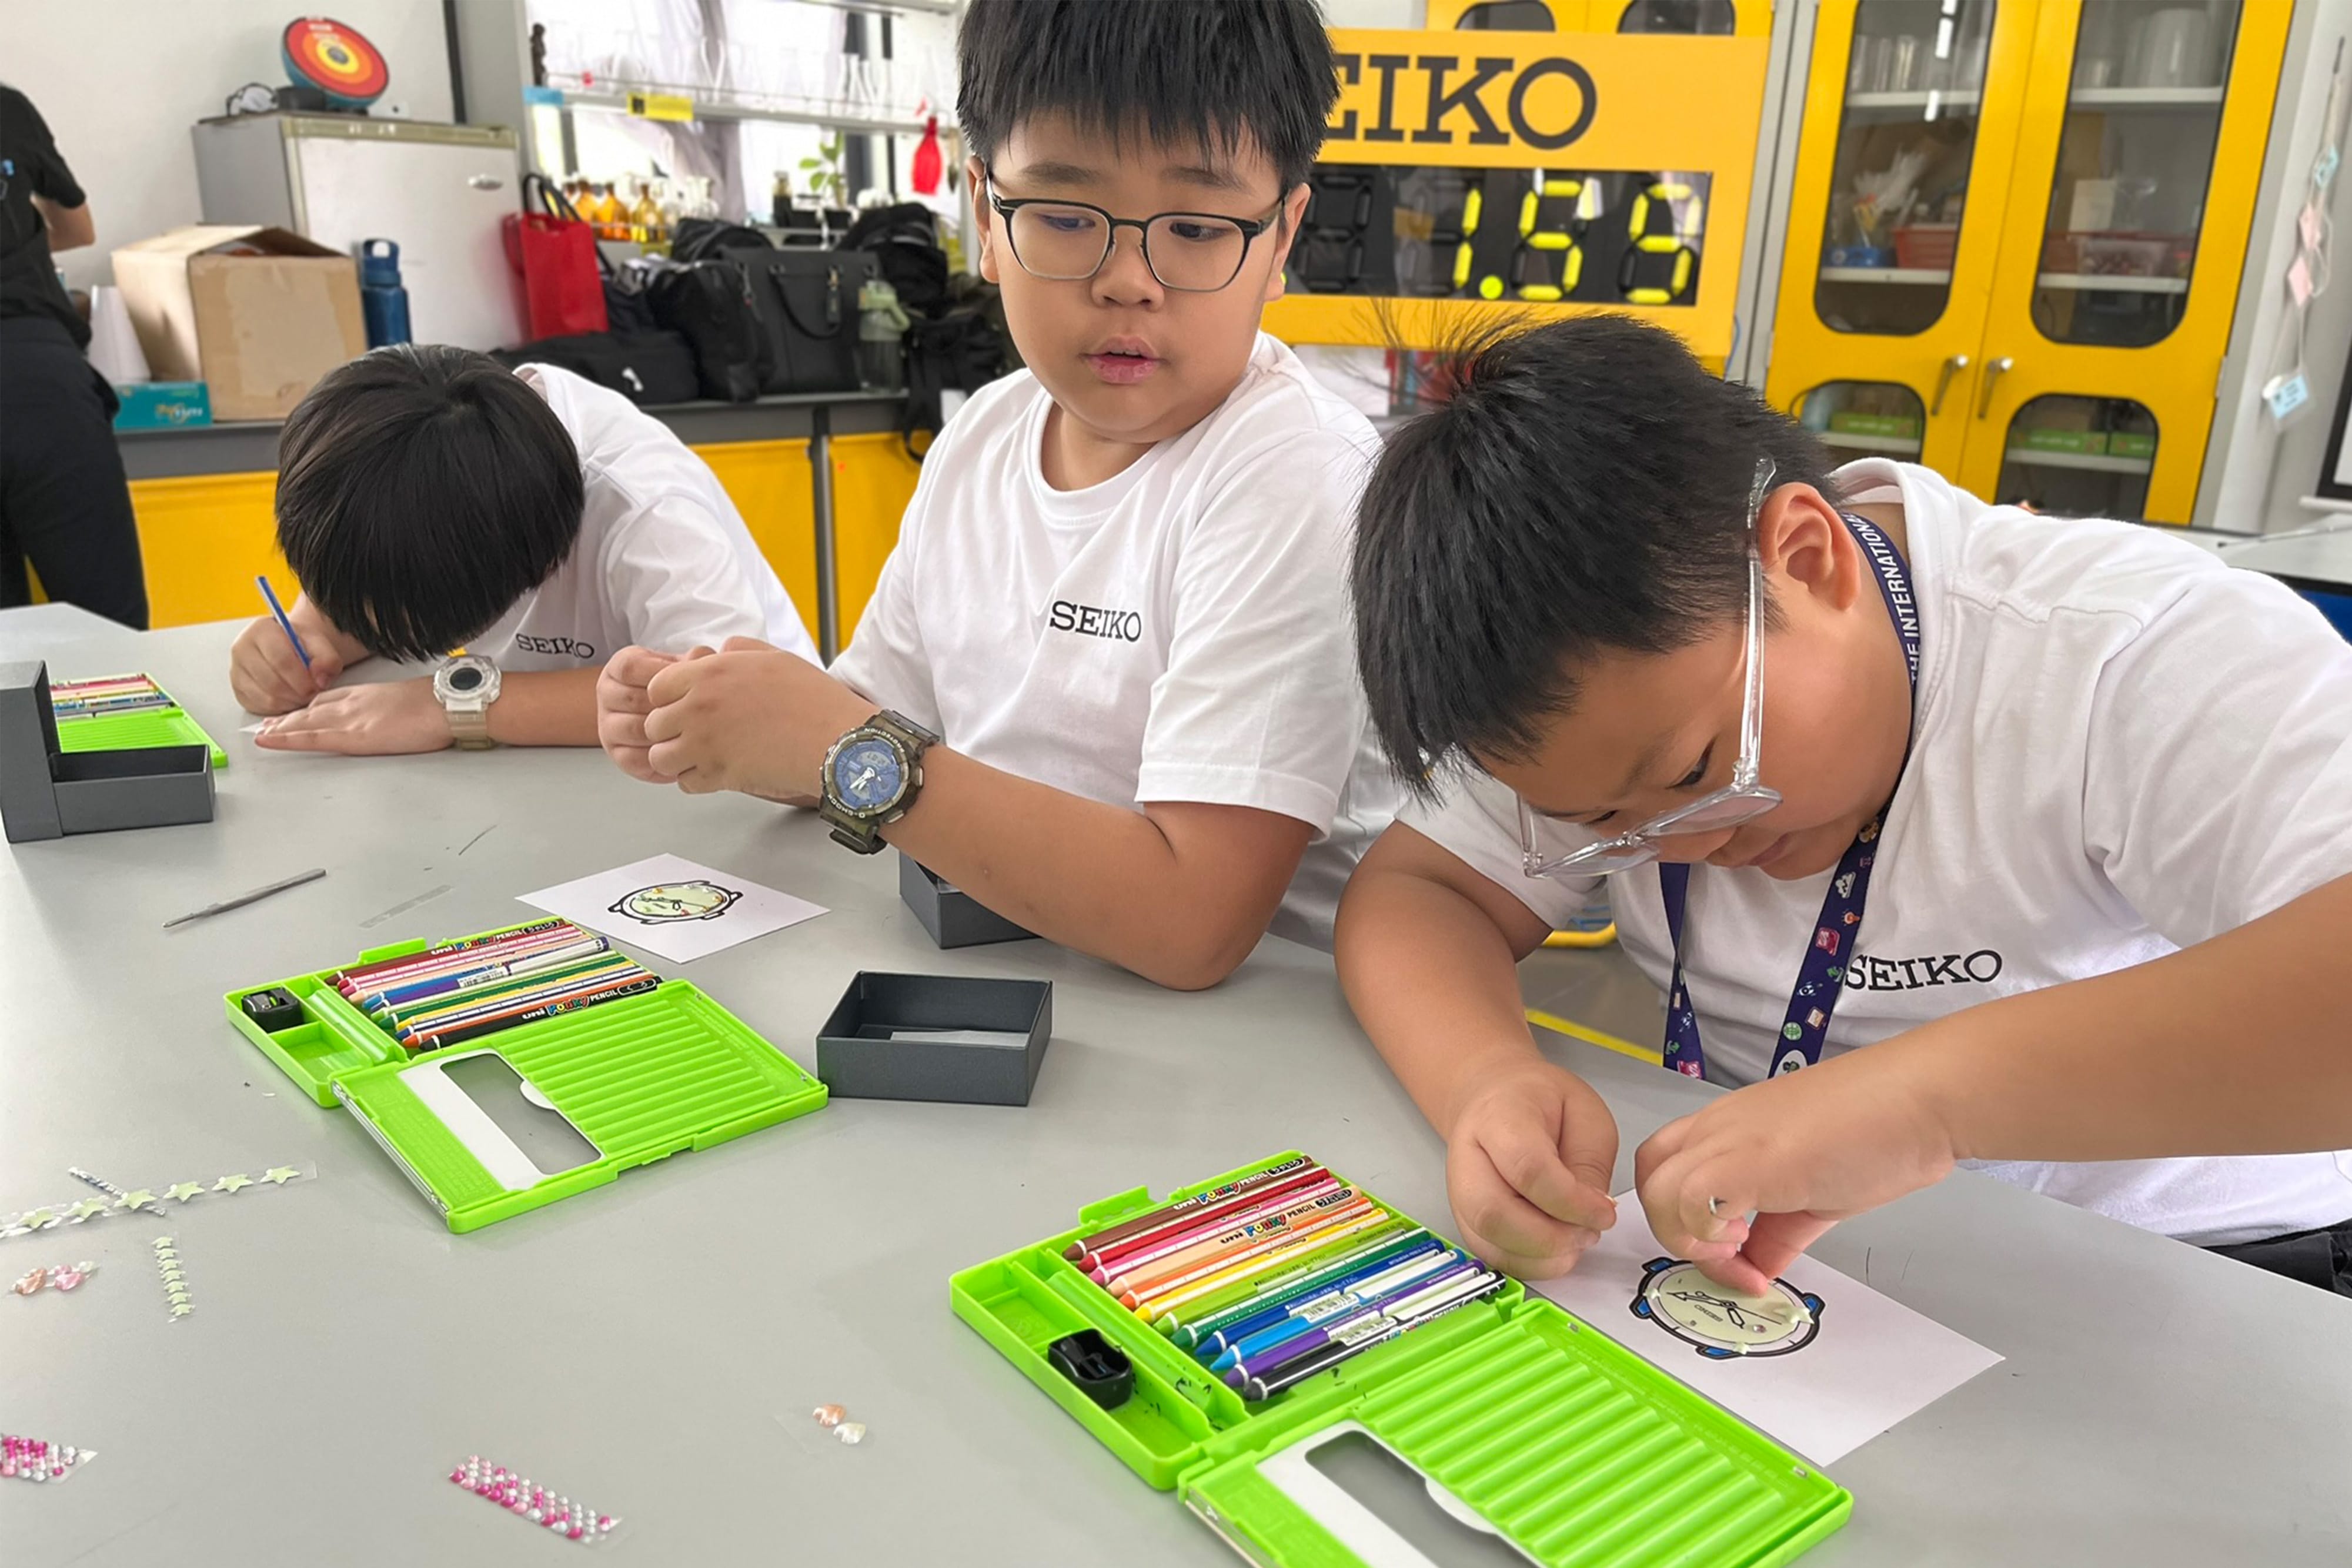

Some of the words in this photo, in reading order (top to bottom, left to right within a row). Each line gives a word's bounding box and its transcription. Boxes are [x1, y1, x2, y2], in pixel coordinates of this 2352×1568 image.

[1049, 600, 1141, 642] SEIKO
[516, 633, 594, 658] SEIKO
[431, 945, 453, 955] uni
[496, 929, 523, 941] PENCIL
[1845, 950, 2002, 991] SEIKO
[522, 1009, 545, 1019] uni
[590, 989, 617, 1002] PENCIL
[1173, 1199, 1197, 1210] uni
[1240, 1172, 1268, 1186] PENCIL
[1220, 1231, 1244, 1244] uni
[1288, 1204, 1316, 1219] PENCIL
